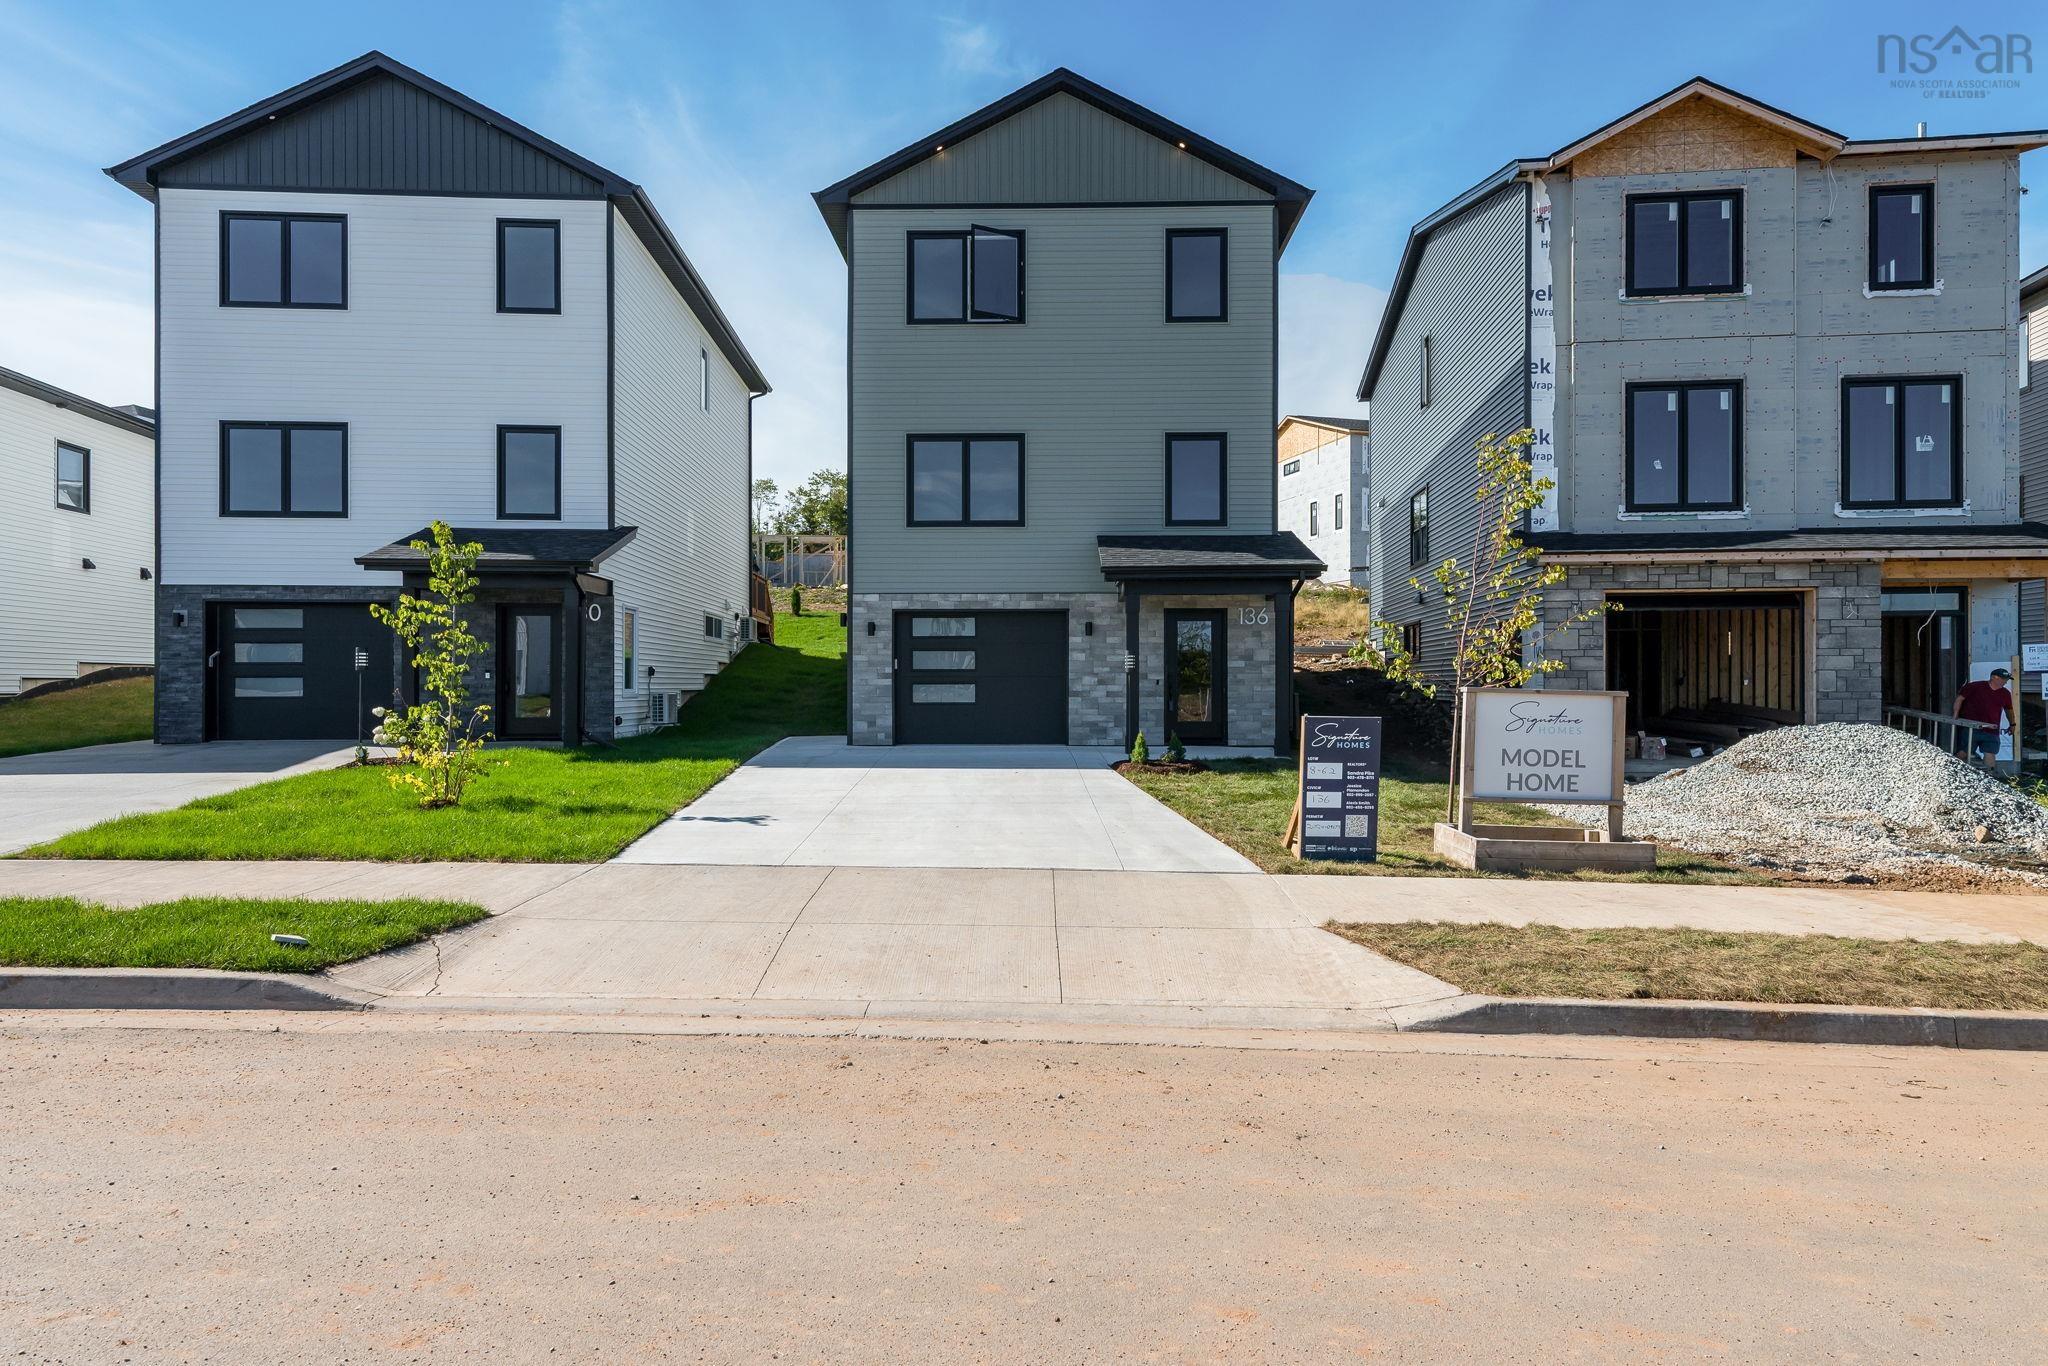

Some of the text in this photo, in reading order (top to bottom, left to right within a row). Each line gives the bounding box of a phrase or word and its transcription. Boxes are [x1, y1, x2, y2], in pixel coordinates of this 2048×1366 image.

[585, 603, 601, 622] 0
[1239, 607, 1269, 625] 136
[1505, 700, 1583, 734] Signature
[1311, 722, 1371, 748] Signature
[1538, 726, 1582, 735] HOMES
[1336, 741, 1370, 749] HOMES
[1501, 748, 1586, 769] MODEL
[1506, 772, 1579, 793] HOME
